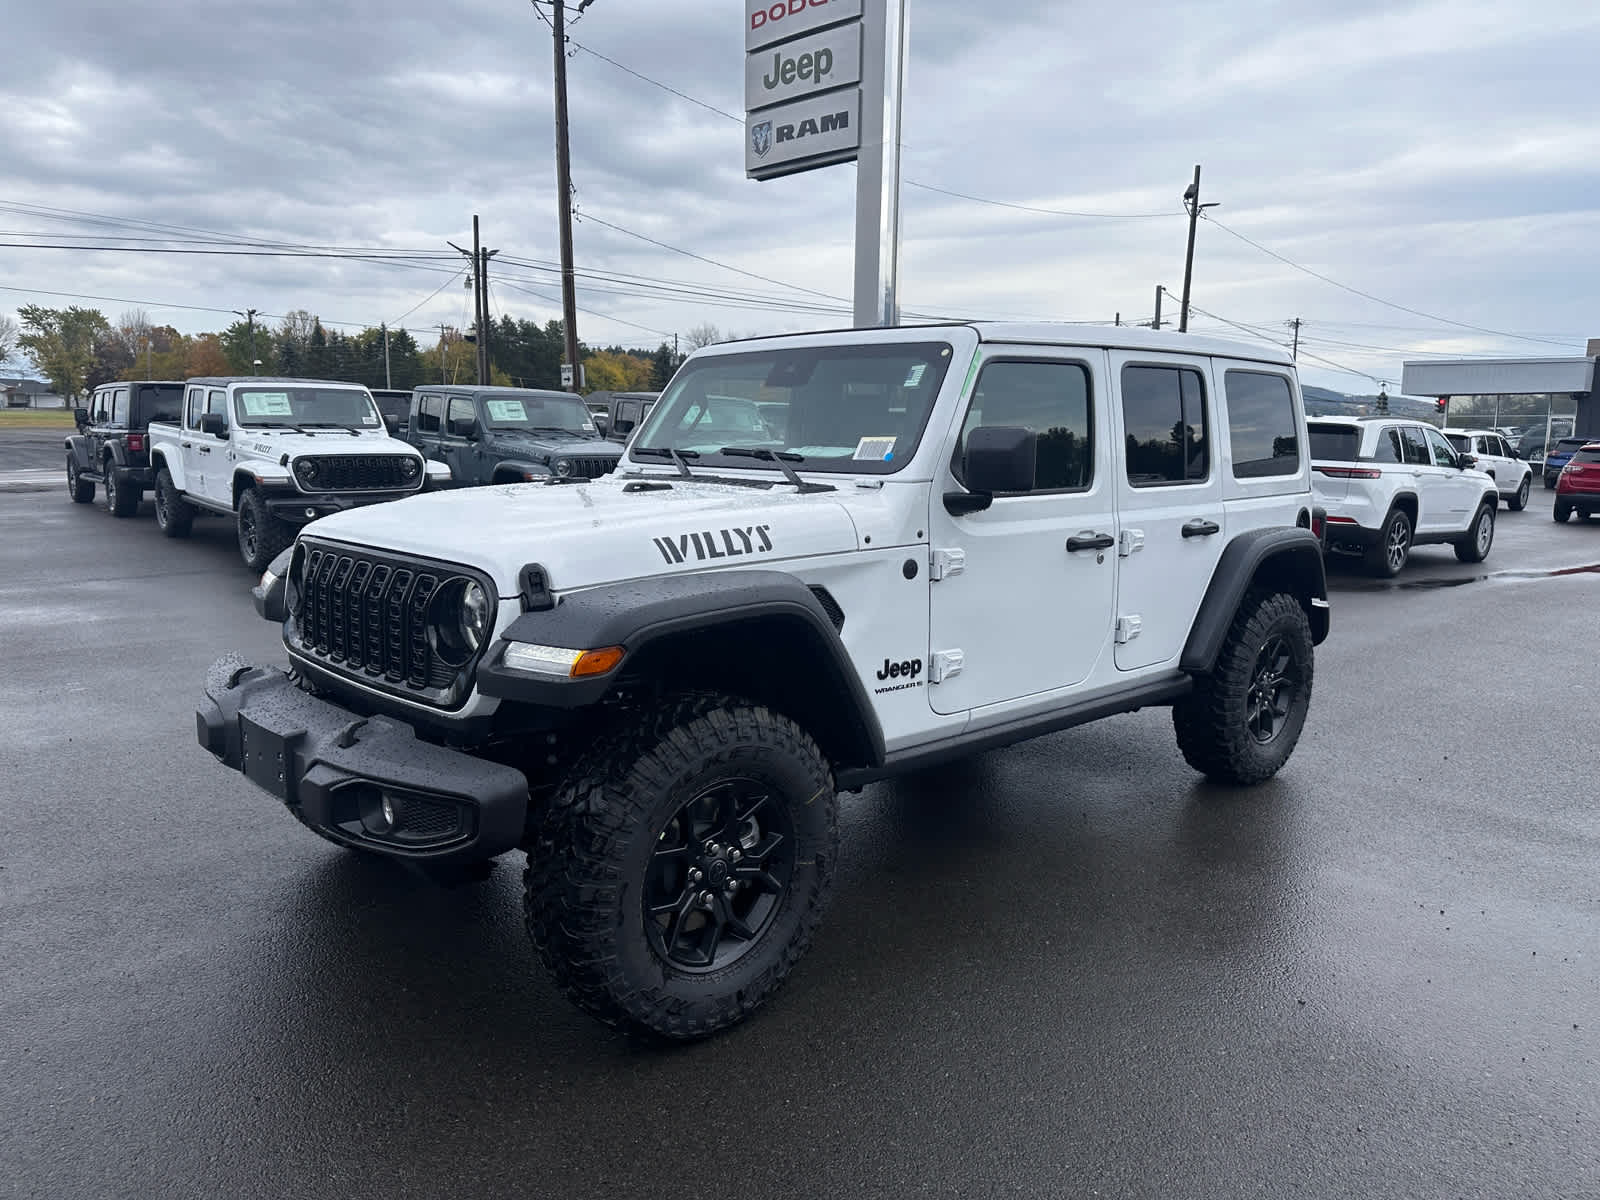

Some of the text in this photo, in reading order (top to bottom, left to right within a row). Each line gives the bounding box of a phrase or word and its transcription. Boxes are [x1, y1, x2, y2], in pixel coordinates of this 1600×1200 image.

[763, 47, 833, 90] Jeep
[776, 111, 849, 143] RAM
[652, 524, 773, 565] WILLYS
[876, 658, 922, 681] Jeep
[874, 682, 916, 695] WRANGLER
